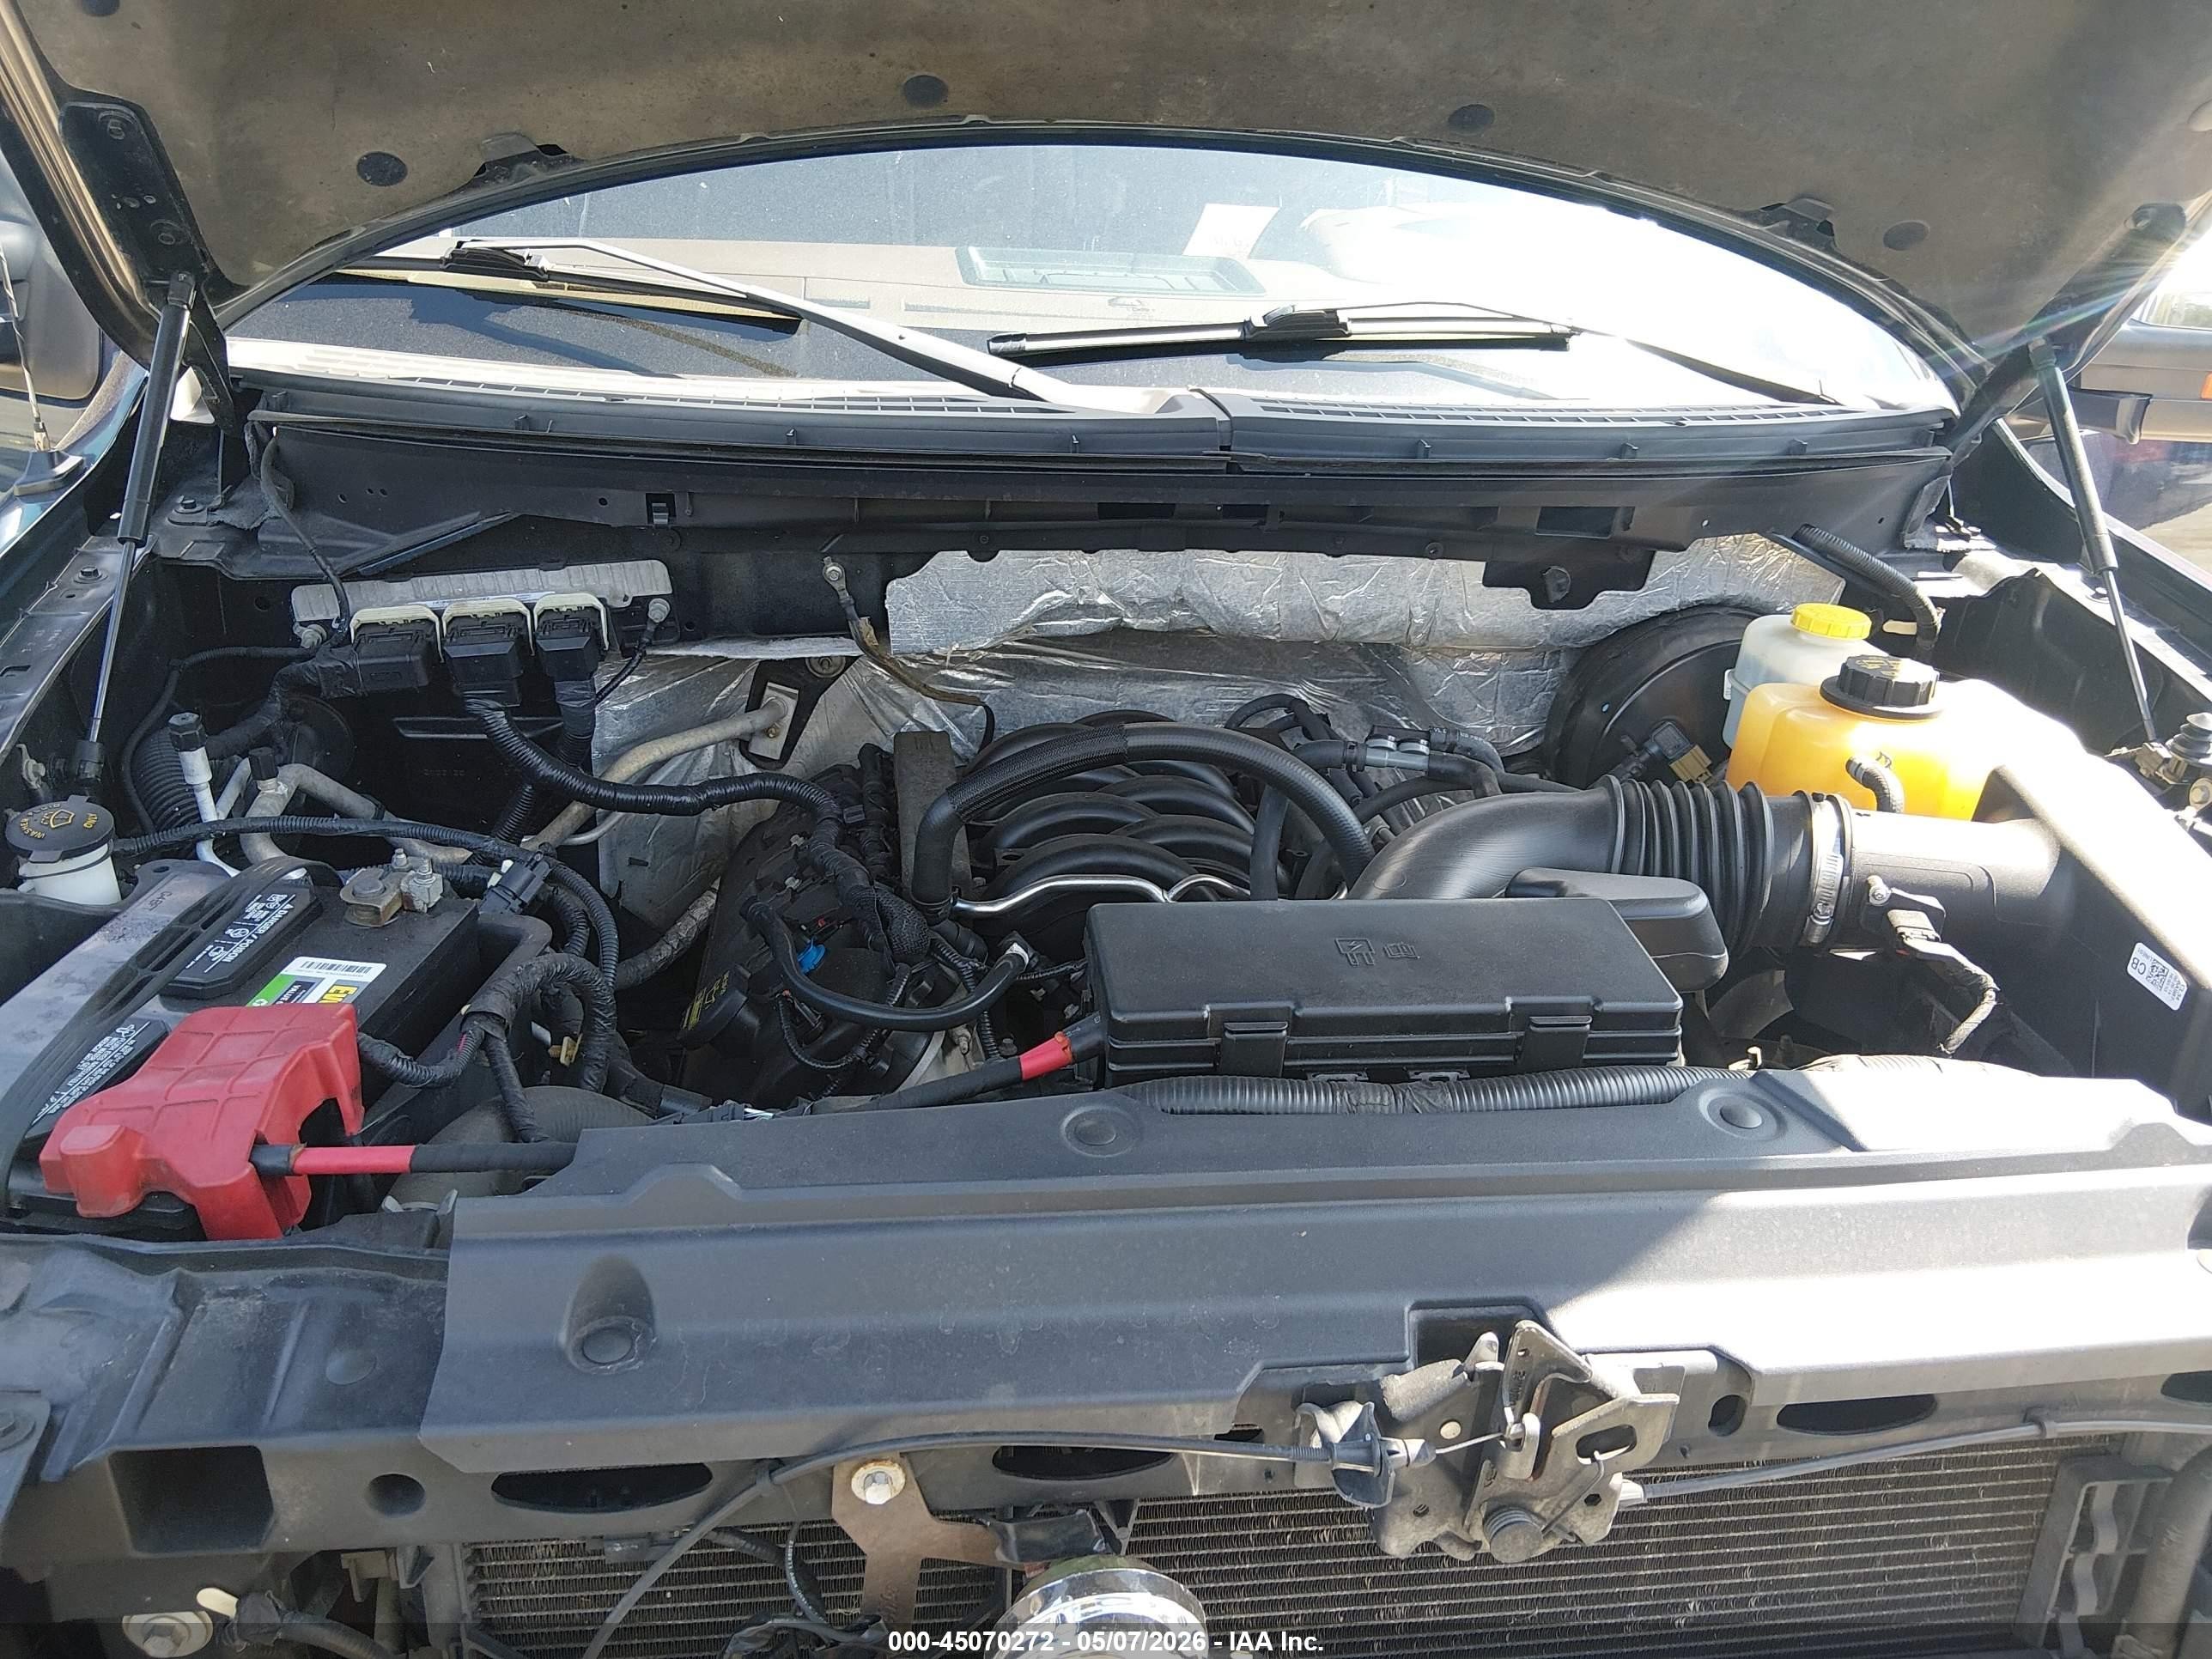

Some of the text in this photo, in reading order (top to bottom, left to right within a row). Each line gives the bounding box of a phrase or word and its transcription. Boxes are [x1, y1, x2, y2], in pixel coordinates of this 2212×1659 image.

[82, 812, 98, 829] ONLY
[257, 909, 289, 934] DANGER
[222, 938, 254, 963] POISON
[2130, 957, 2147, 975] CB
[278, 984, 301, 1002] VALUE
